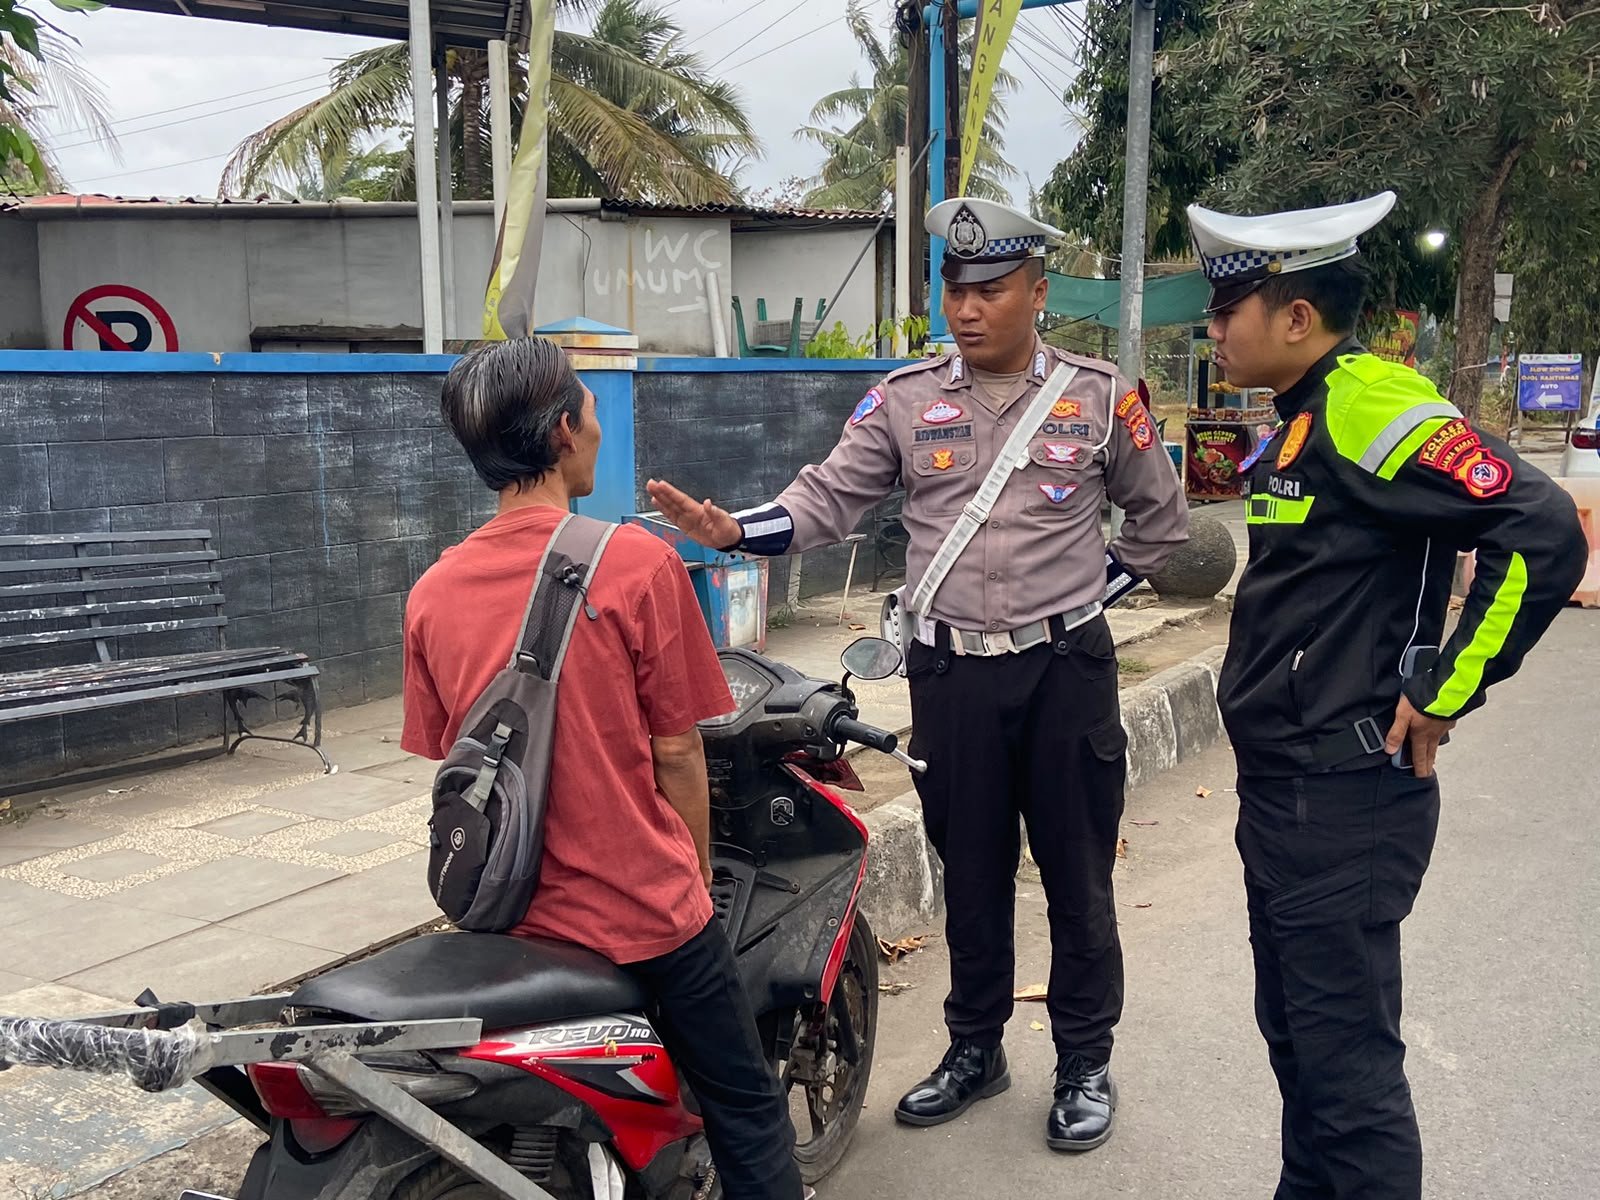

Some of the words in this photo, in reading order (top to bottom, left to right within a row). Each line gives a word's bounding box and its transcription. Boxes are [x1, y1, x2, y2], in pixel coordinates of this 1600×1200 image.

[645, 229, 721, 269] WC
[593, 267, 703, 296] UMUM
[1043, 423, 1089, 436] OLRI
[1423, 421, 1464, 461] POLRES
[1441, 451, 1456, 469] JAWA
[1454, 438, 1475, 453] BARAT
[1268, 475, 1300, 498] POLRI
[528, 1024, 632, 1046] REVO
[629, 1028, 650, 1039] 110
